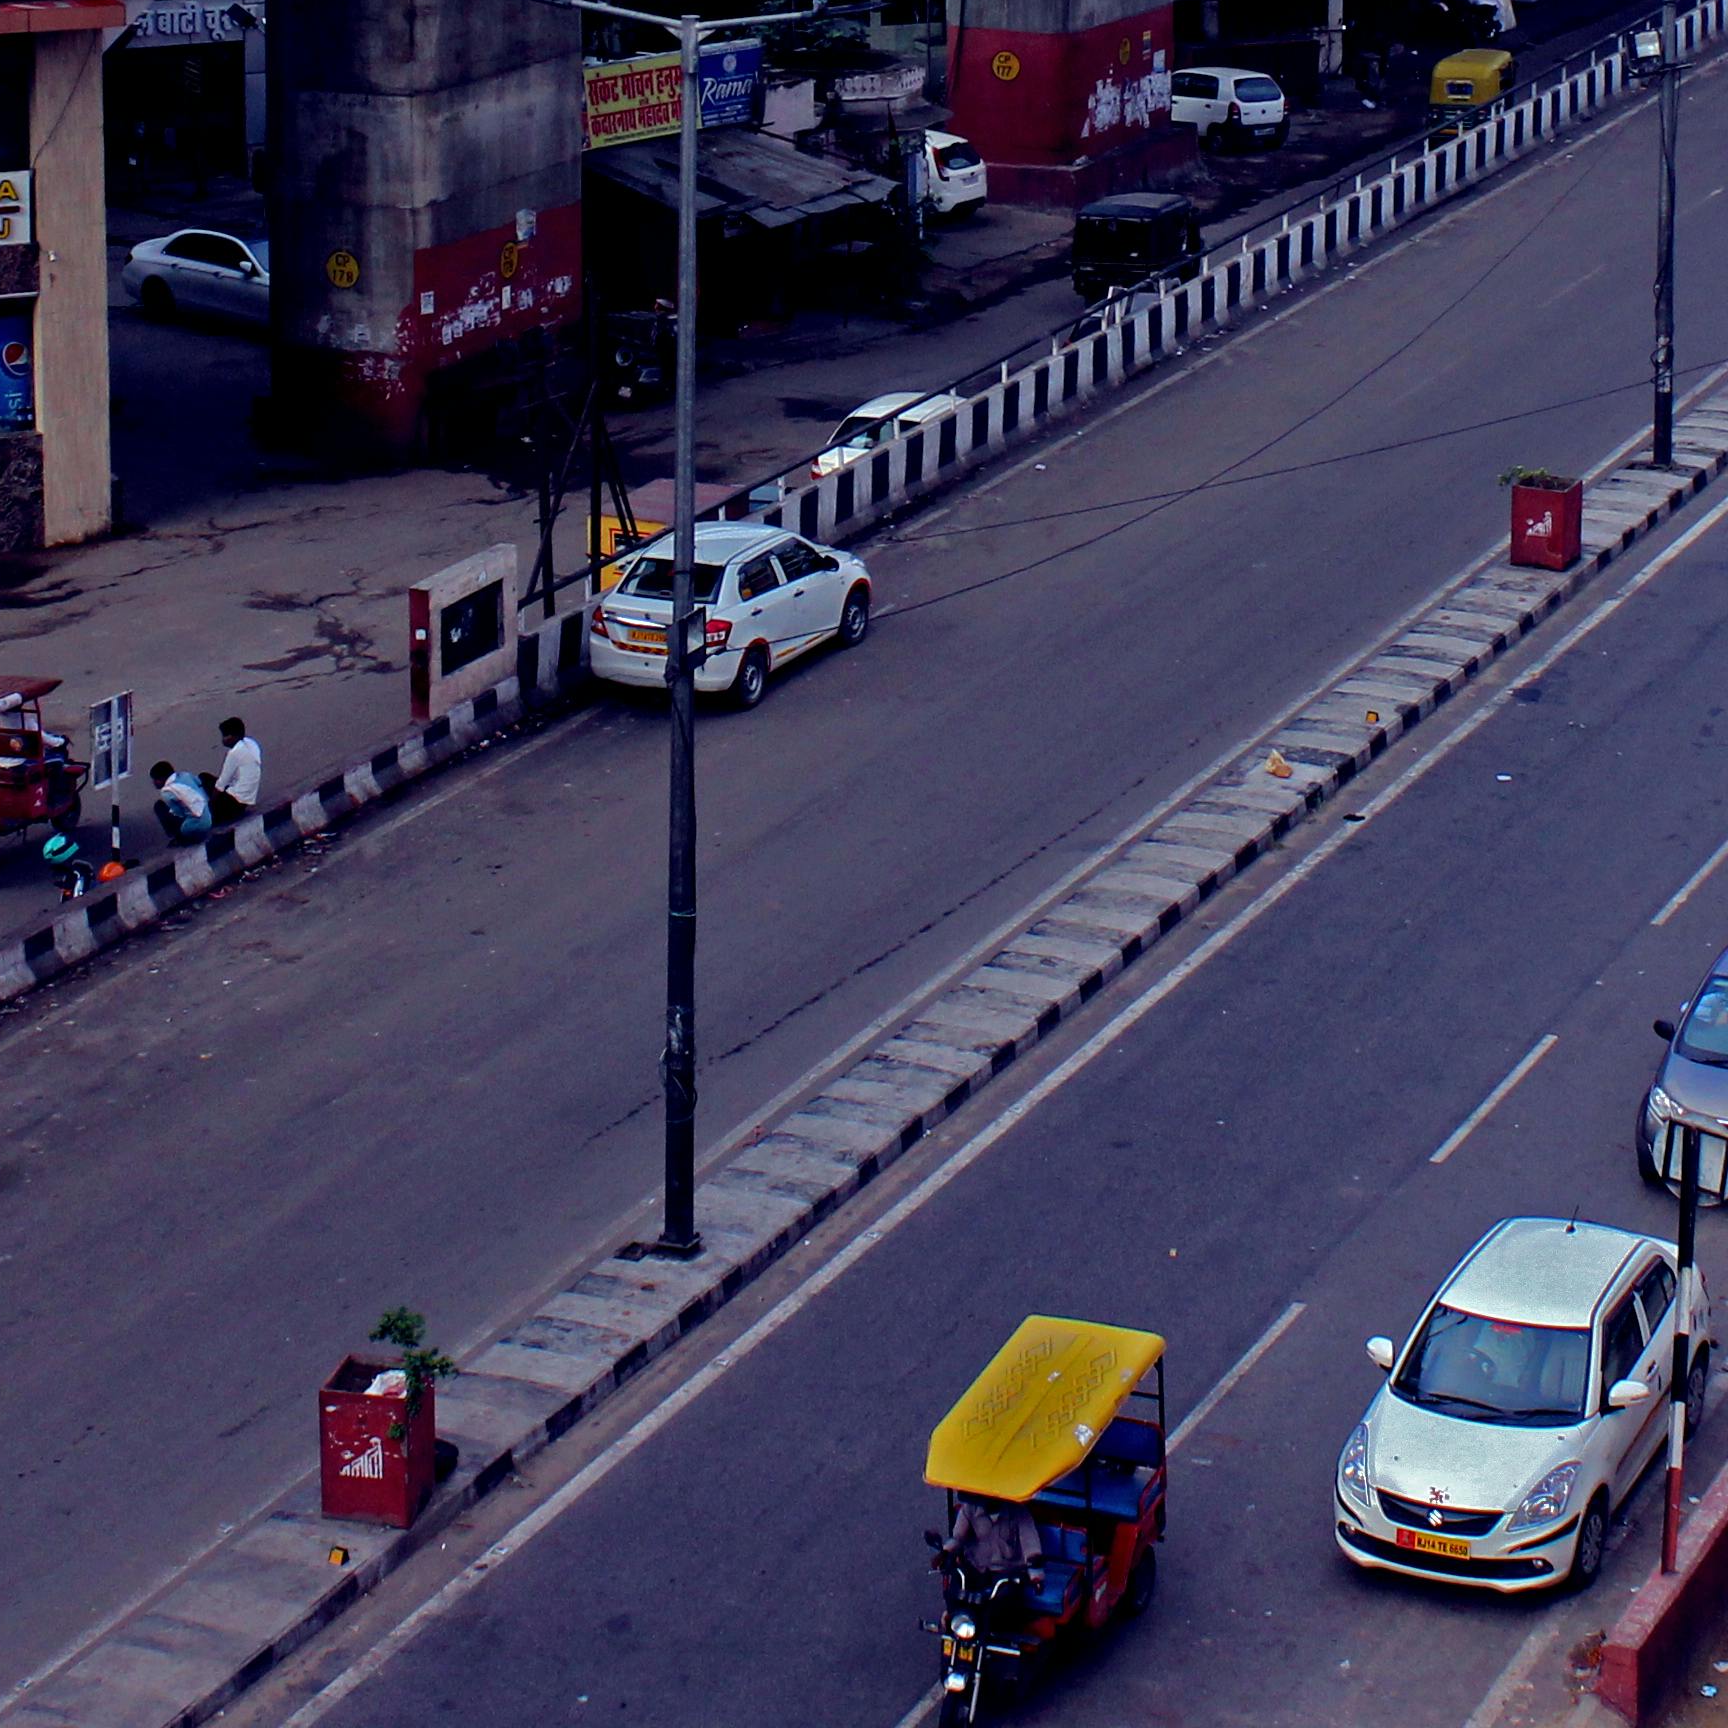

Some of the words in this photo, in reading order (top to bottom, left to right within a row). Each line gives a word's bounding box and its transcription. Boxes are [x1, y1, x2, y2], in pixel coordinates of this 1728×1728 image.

[156, 1, 201, 34] बाटी
[998, 55, 1012, 65] CP
[997, 65, 1012, 77] 177
[587, 73, 620, 106] संकट
[622, 64, 654, 99] मोचन
[591, 107, 636, 136] केदारनाथ
[637, 96, 669, 128] महादेव
[335, 254, 350, 266] CP
[332, 270, 353, 282] 178
[1438, 1541, 1447, 1552] TE
